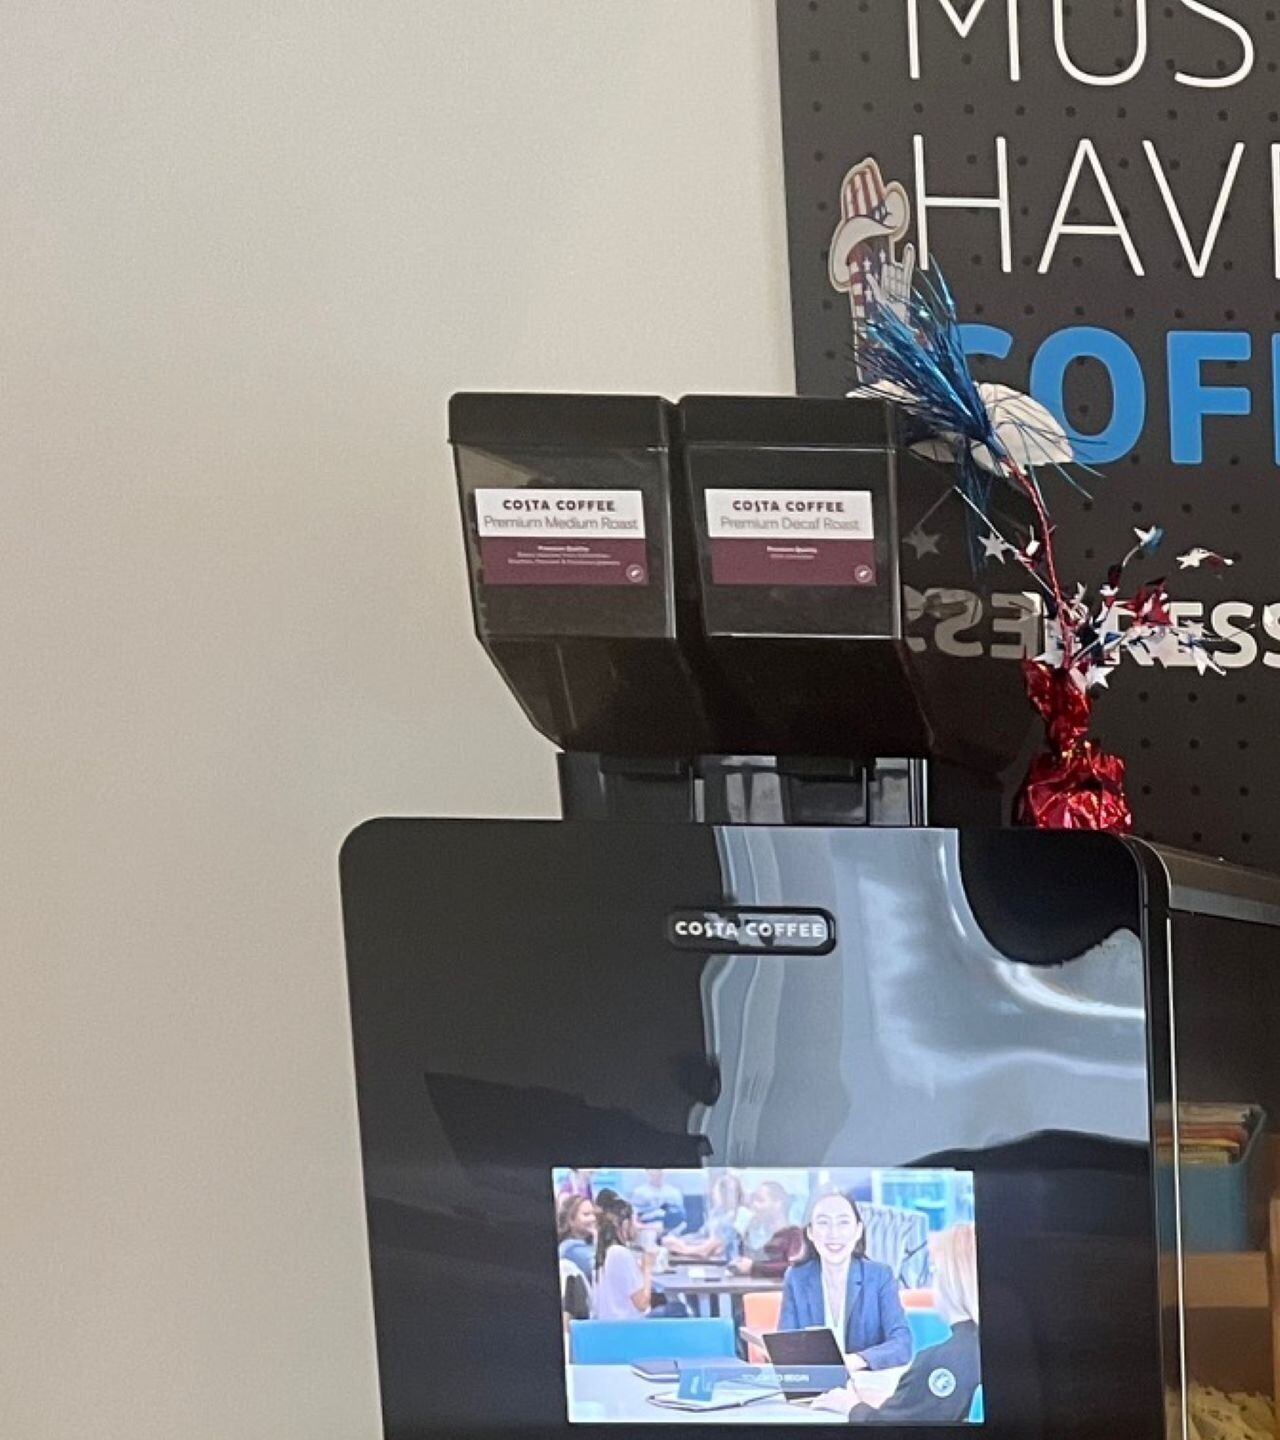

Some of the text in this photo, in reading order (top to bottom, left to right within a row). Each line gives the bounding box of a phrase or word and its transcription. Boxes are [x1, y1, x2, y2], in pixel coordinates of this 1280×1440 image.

[503, 500, 615, 512] COSTA COFFEE
[733, 500, 844, 512] COSTA COFFEE
[484, 516, 638, 530] Premium Medium Roast
[721, 516, 859, 530] Premium Decaf Roast
[675, 921, 825, 938] COSTA COFFEE
